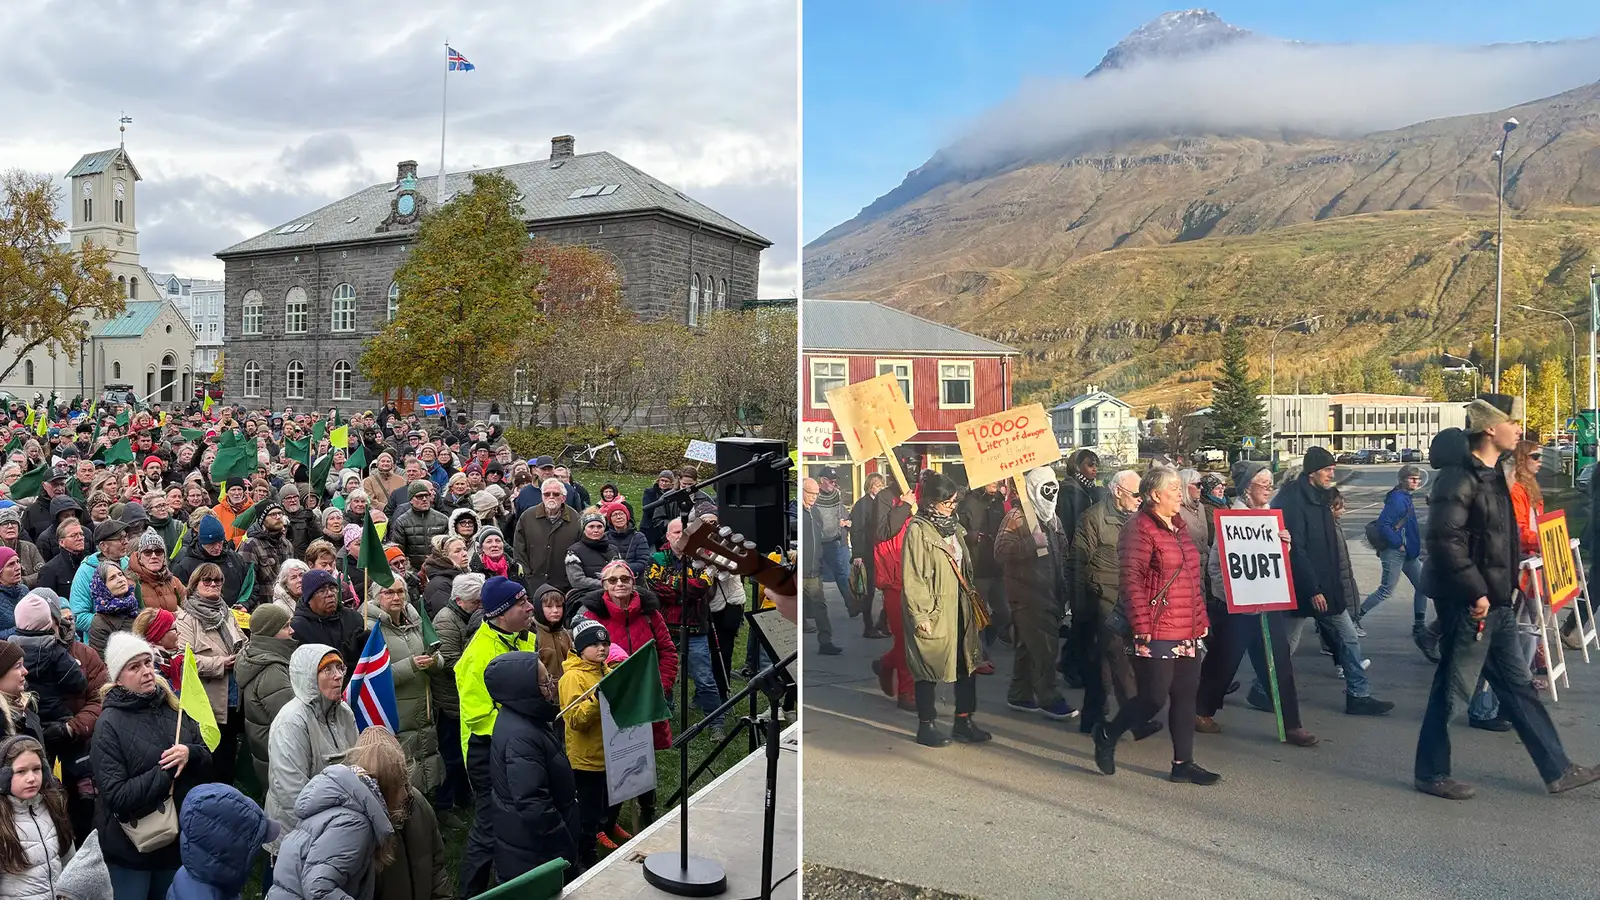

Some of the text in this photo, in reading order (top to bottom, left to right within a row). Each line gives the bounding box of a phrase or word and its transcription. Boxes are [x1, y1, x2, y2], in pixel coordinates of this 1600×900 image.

[815, 426, 832, 434] FULL
[967, 416, 1029, 441] 40.000
[977, 438, 1009, 454] Liters
[1012, 431, 1020, 441] of
[1000, 452, 1035, 470] first!!!
[1225, 524, 1274, 542] KALDVÍK
[1228, 552, 1281, 580] BURT
